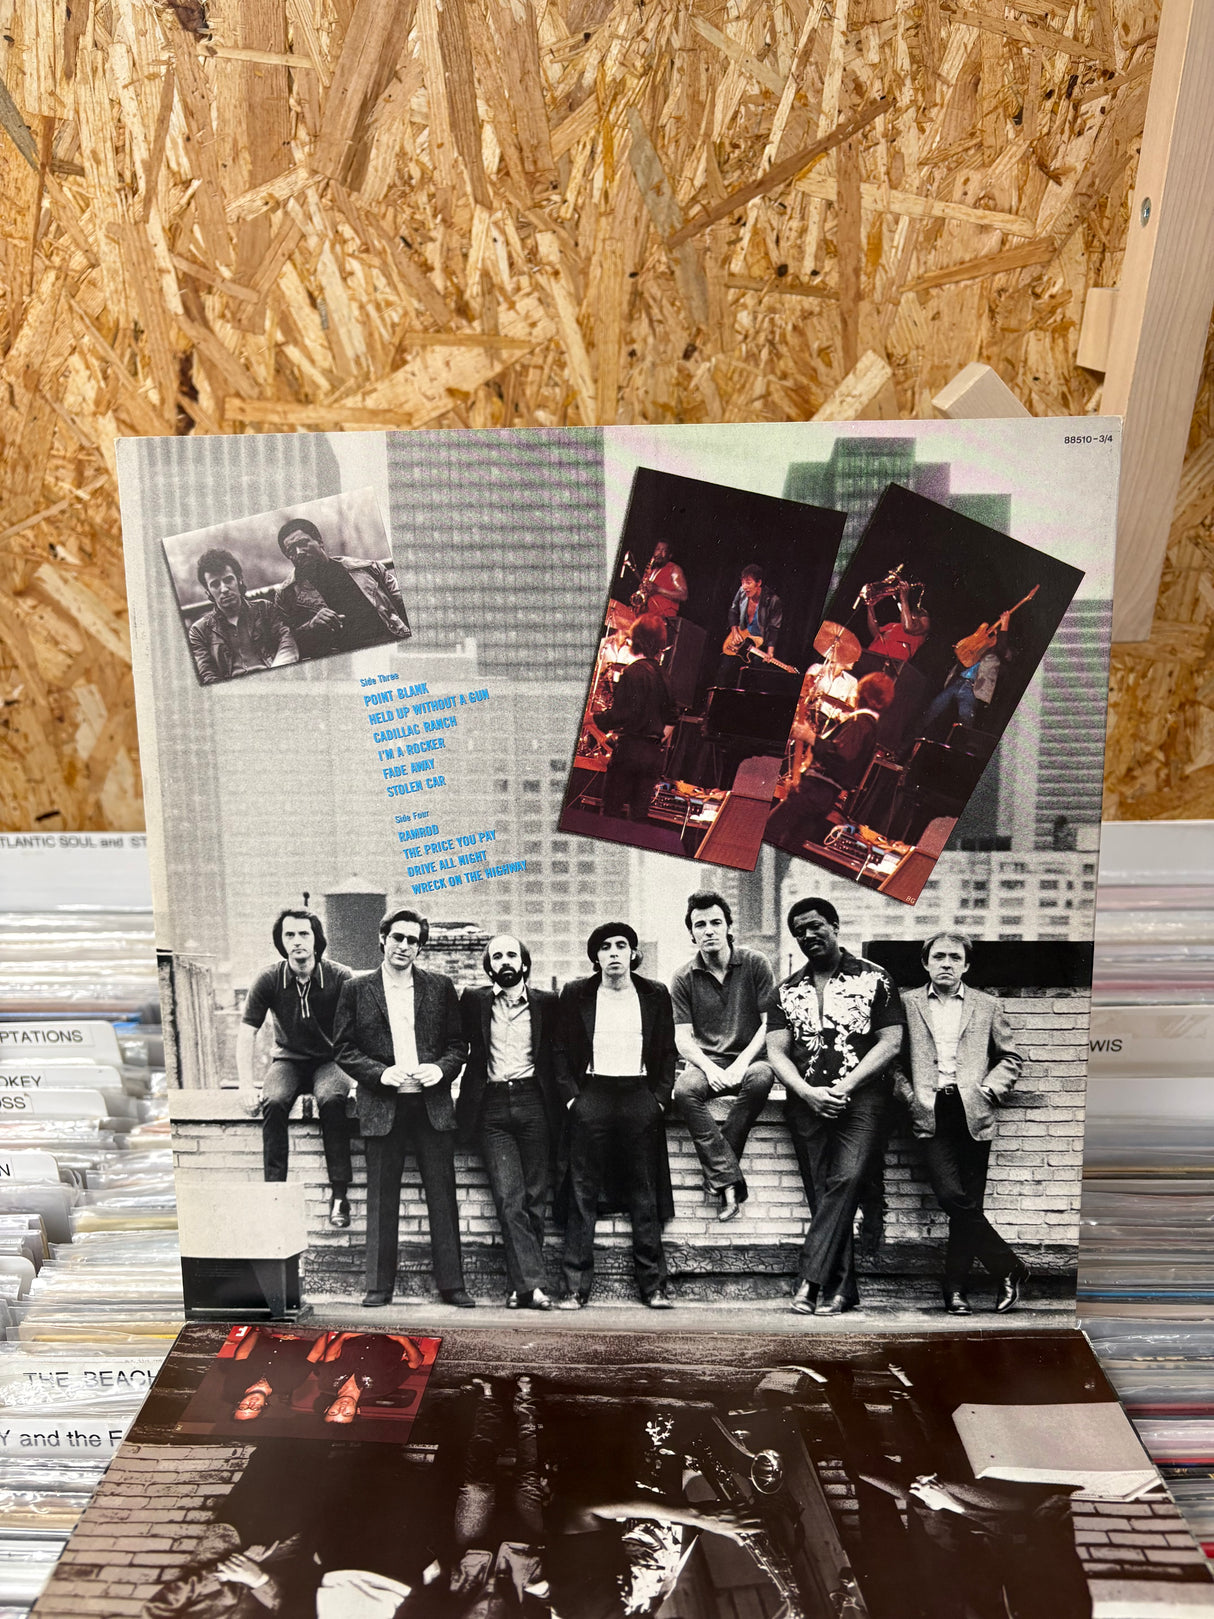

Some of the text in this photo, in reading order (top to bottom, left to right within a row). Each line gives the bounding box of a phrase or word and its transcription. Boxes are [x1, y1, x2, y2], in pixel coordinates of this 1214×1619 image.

[1064, 435, 1113, 444] 88510-3/4
[360, 673, 399, 687] Side Three
[363, 682, 429, 707] POINT BLANK
[368, 688, 490, 725] HELD UP WITHOUT A GUN
[373, 715, 457, 743] CADILLAC RANCH
[378, 737, 446, 761] I'M A ROCKER
[383, 758, 435, 779] FADE AWAY
[386, 775, 446, 797] STOLEN CAR
[394, 811, 429, 824] Side Four
[59, 835, 97, 849] SOUL
[100, 838, 124, 848] and
[398, 824, 439, 842] RAMROD
[402, 829, 496, 860] THE PRICE YOU PAY
[407, 850, 487, 877] DRIVE ALL NIGHT
[411, 860, 527, 895] WRECK ON THE HIGHWAY
[1089, 1038, 1123, 1052] WIS
[23, 1372, 69, 1388] THE
[20, 1430, 60, 1447] and
[66, 1430, 101, 1447] the
